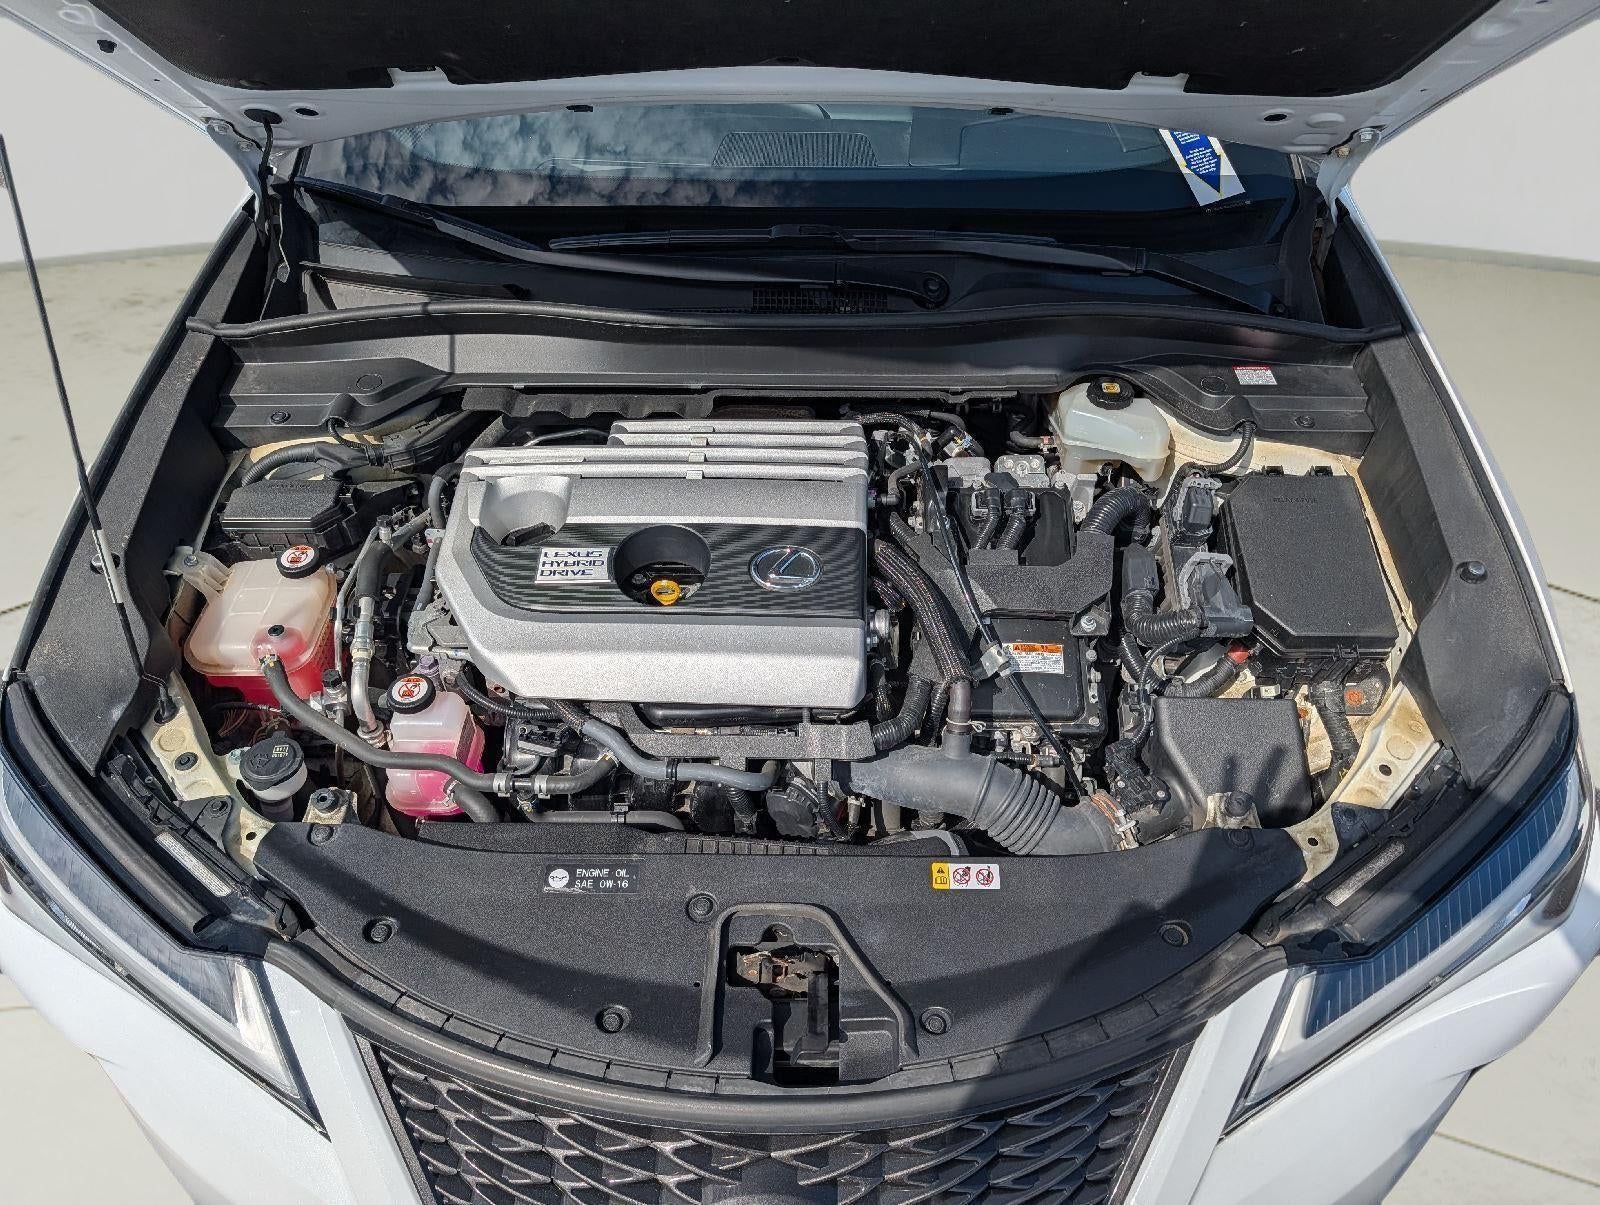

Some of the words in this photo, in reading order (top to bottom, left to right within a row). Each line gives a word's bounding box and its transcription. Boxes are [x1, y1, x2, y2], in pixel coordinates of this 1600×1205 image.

[543, 550, 603, 558] LEXUS
[541, 559, 605, 567] HYBRID
[539, 568, 594, 577] DRIVE
[575, 868, 610, 878] ENGINE
[615, 868, 630, 878] OIL
[575, 879, 594, 889] SAE
[599, 879, 629, 889] 0W-16
